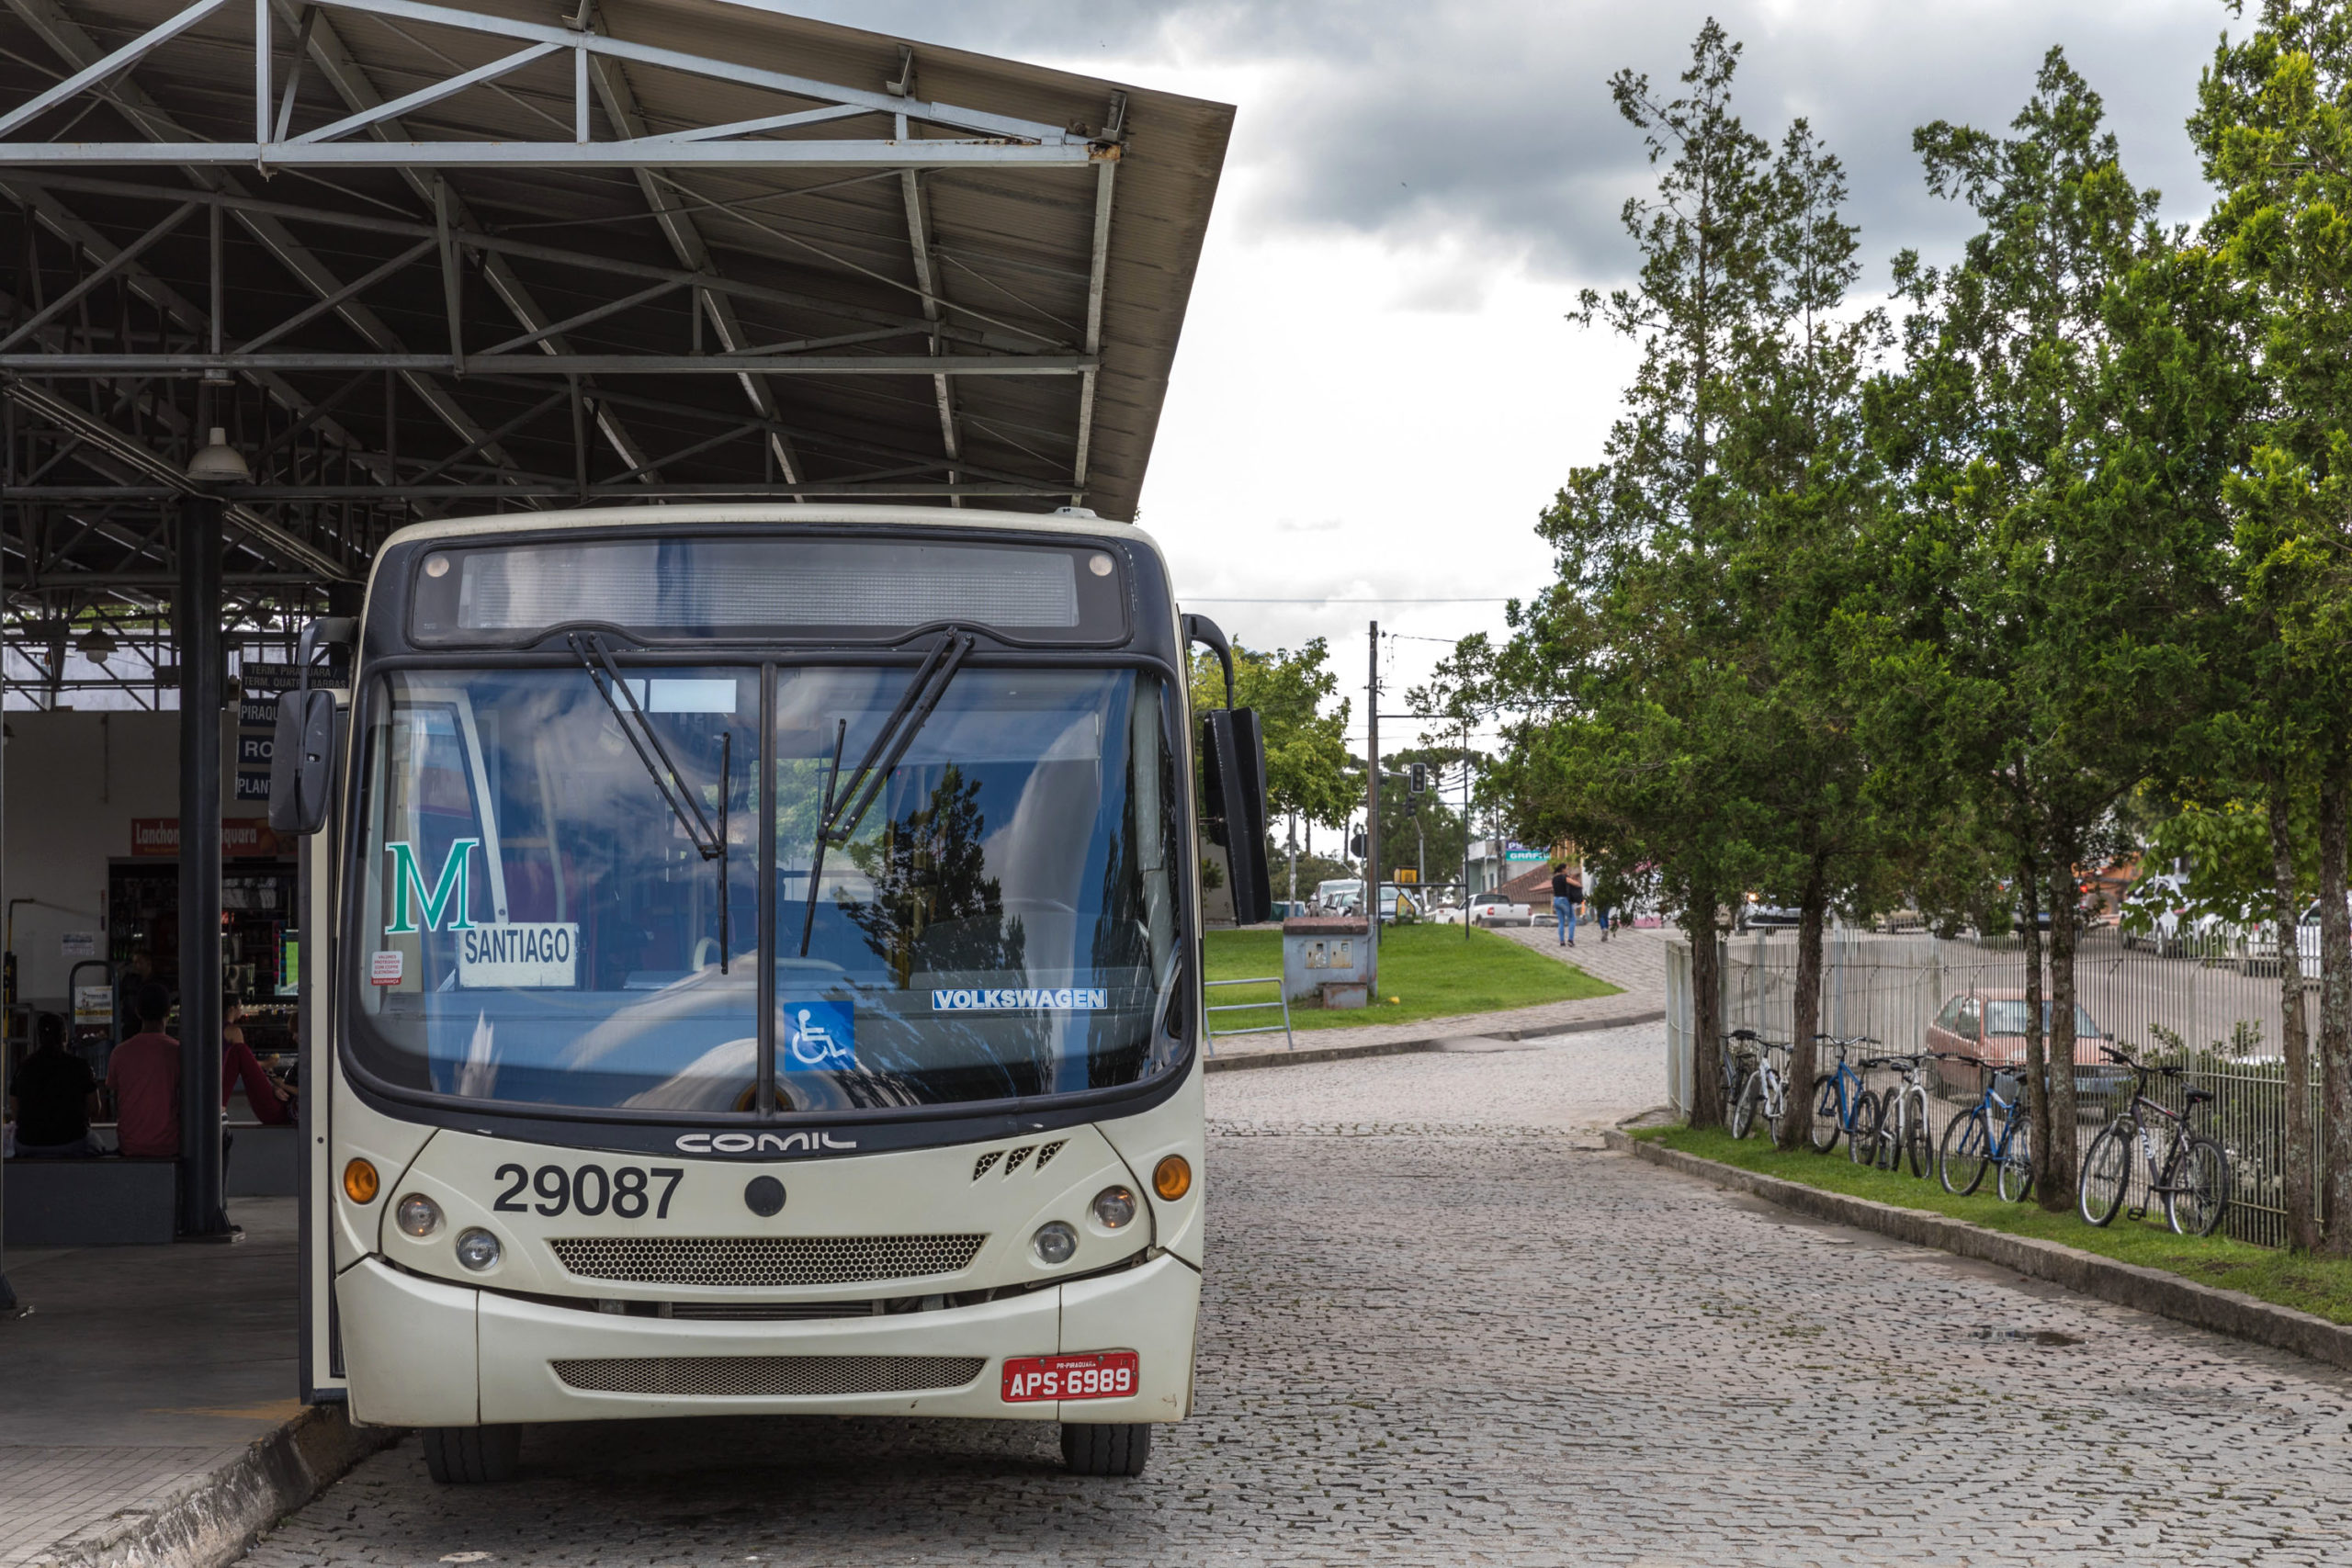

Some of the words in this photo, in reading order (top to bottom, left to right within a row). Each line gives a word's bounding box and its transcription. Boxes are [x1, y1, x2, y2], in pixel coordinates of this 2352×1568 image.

[252, 665, 277, 675] TERM.
[280, 666, 331, 677] PIRAUARA
[243, 676, 271, 686] TERM.
[273, 678, 301, 687] QUATR
[312, 680, 346, 689] BARRAS
[241, 705, 277, 721] PIRAQU
[244, 740, 274, 757] RO
[238, 778, 271, 795] PLAN
[136, 820, 179, 844] Lanchon
[385, 838, 480, 935] M
[465, 928, 570, 964] SANTIAGO
[935, 989, 1104, 1009] VOLKSWAGEN
[675, 1132, 857, 1153] COMIL
[493, 1163, 684, 1219] 29087
